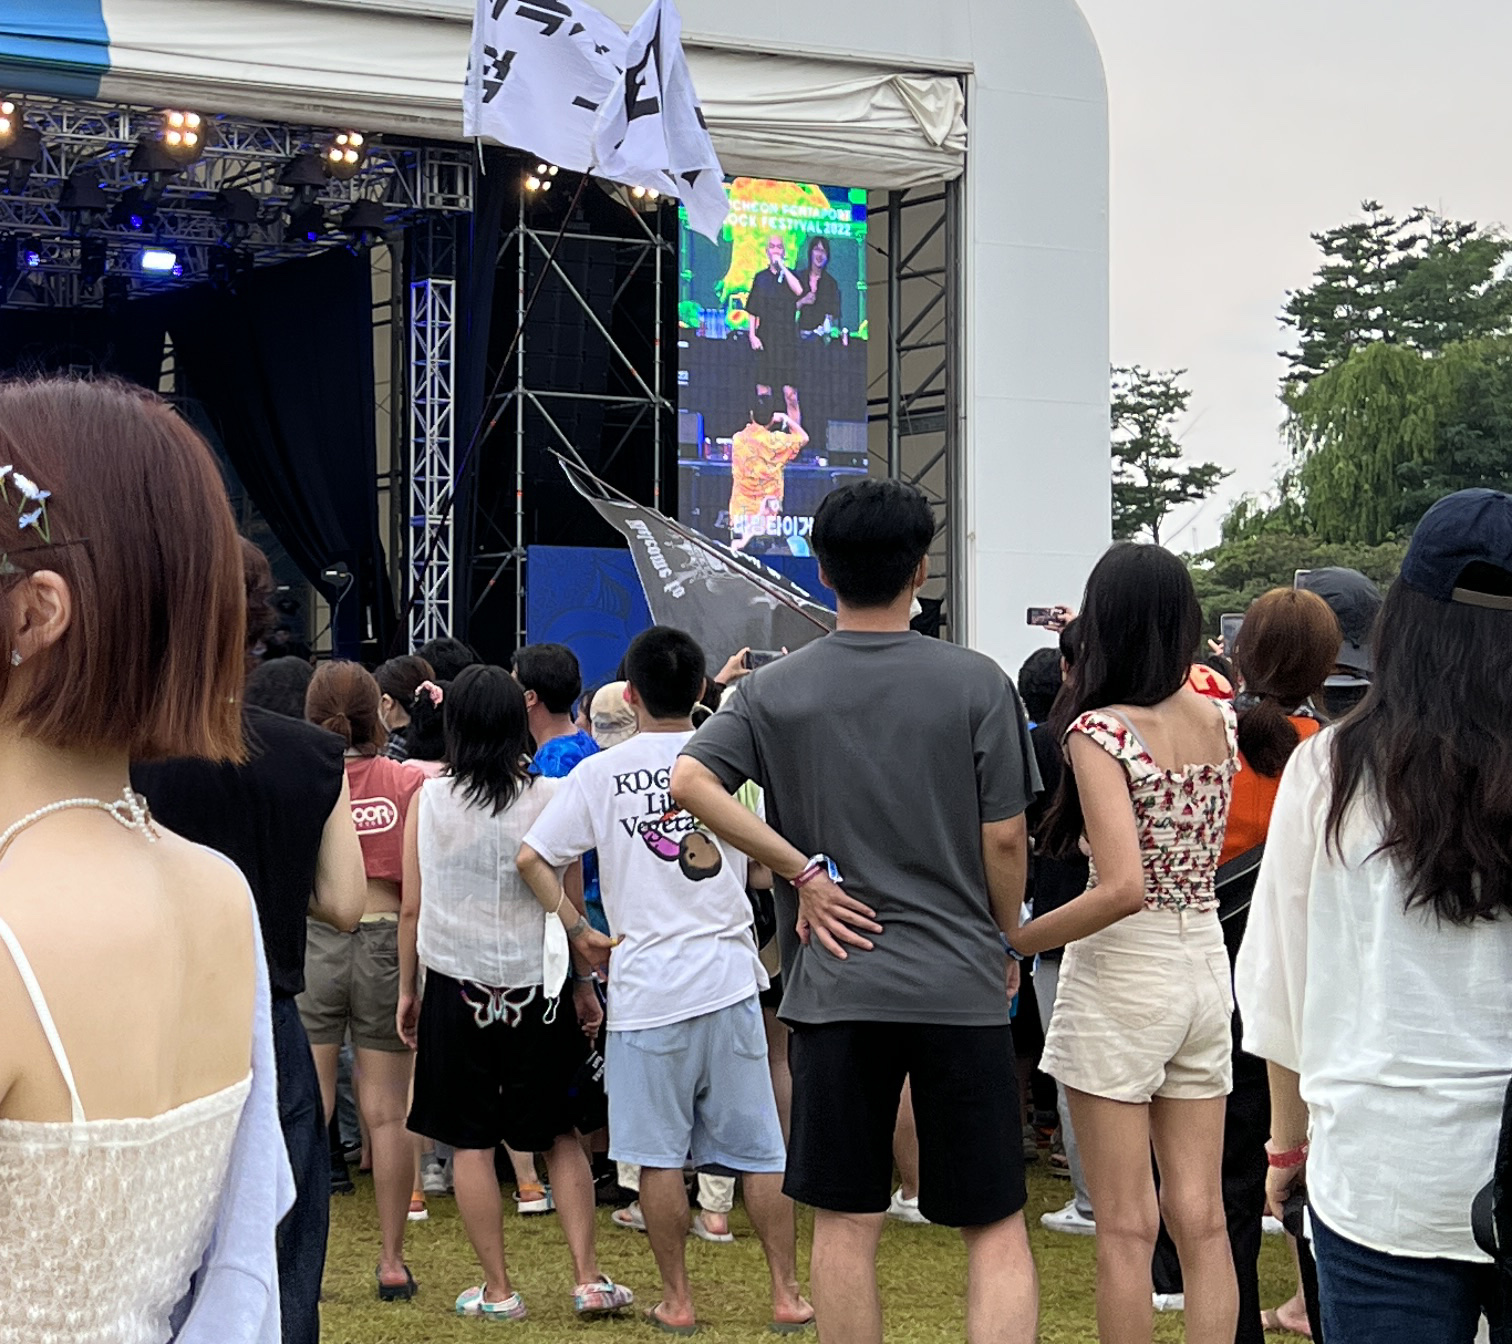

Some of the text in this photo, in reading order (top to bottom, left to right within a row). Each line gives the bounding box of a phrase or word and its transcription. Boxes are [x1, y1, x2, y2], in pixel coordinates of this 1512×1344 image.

[723, 212, 757, 228] OCK
[823, 222, 852, 237] 2022
[613, 766, 672, 796] KDG
[351, 805, 391, 825] OOR
[644, 790, 681, 816] Lik
[619, 814, 698, 843] Vegeta
